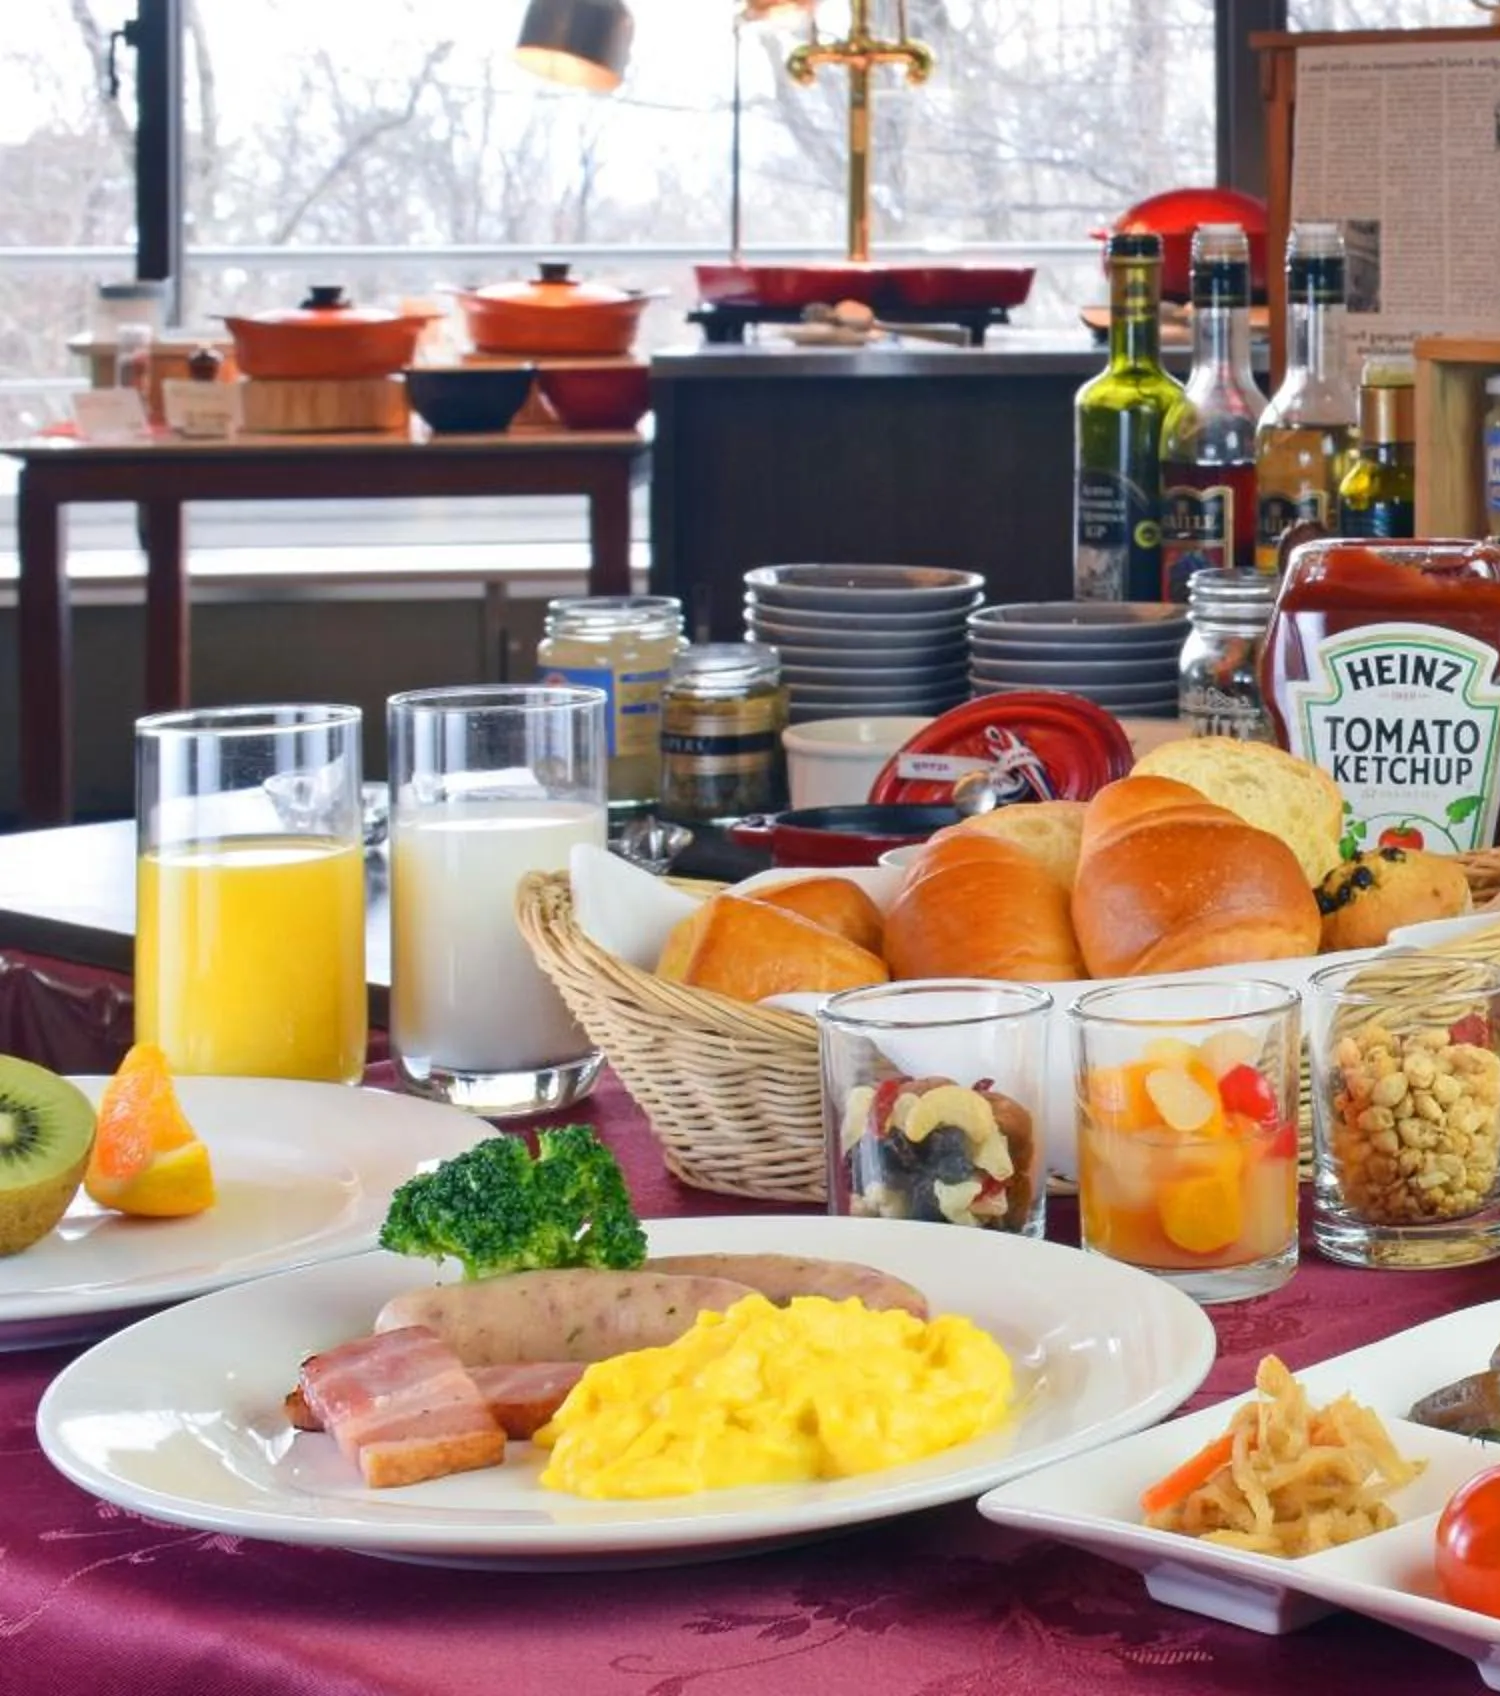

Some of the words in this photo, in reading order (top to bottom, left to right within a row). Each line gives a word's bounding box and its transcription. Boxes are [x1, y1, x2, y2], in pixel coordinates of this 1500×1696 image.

[1344, 653, 1464, 694] HEINZ
[1324, 715, 1480, 755] TOMATO
[1333, 755, 1473, 785] KETCHUP
